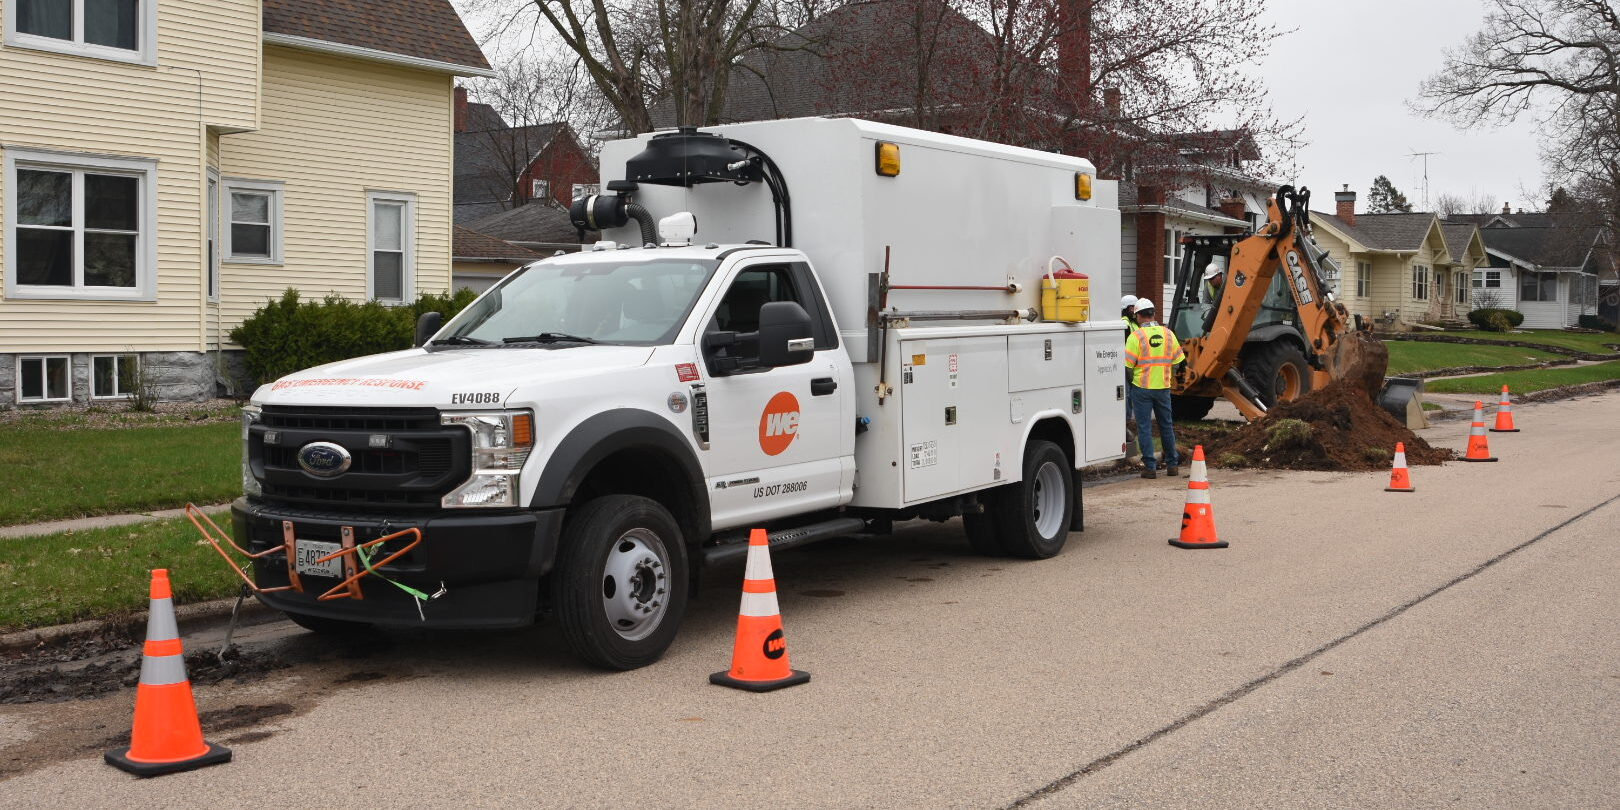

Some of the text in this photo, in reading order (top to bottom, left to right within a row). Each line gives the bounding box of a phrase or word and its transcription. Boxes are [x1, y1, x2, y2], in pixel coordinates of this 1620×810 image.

[1286, 250, 1313, 305] CASE
[451, 392, 500, 404] EV4088
[309, 450, 335, 466] Ford
[753, 480, 808, 498] US DOT 288006
